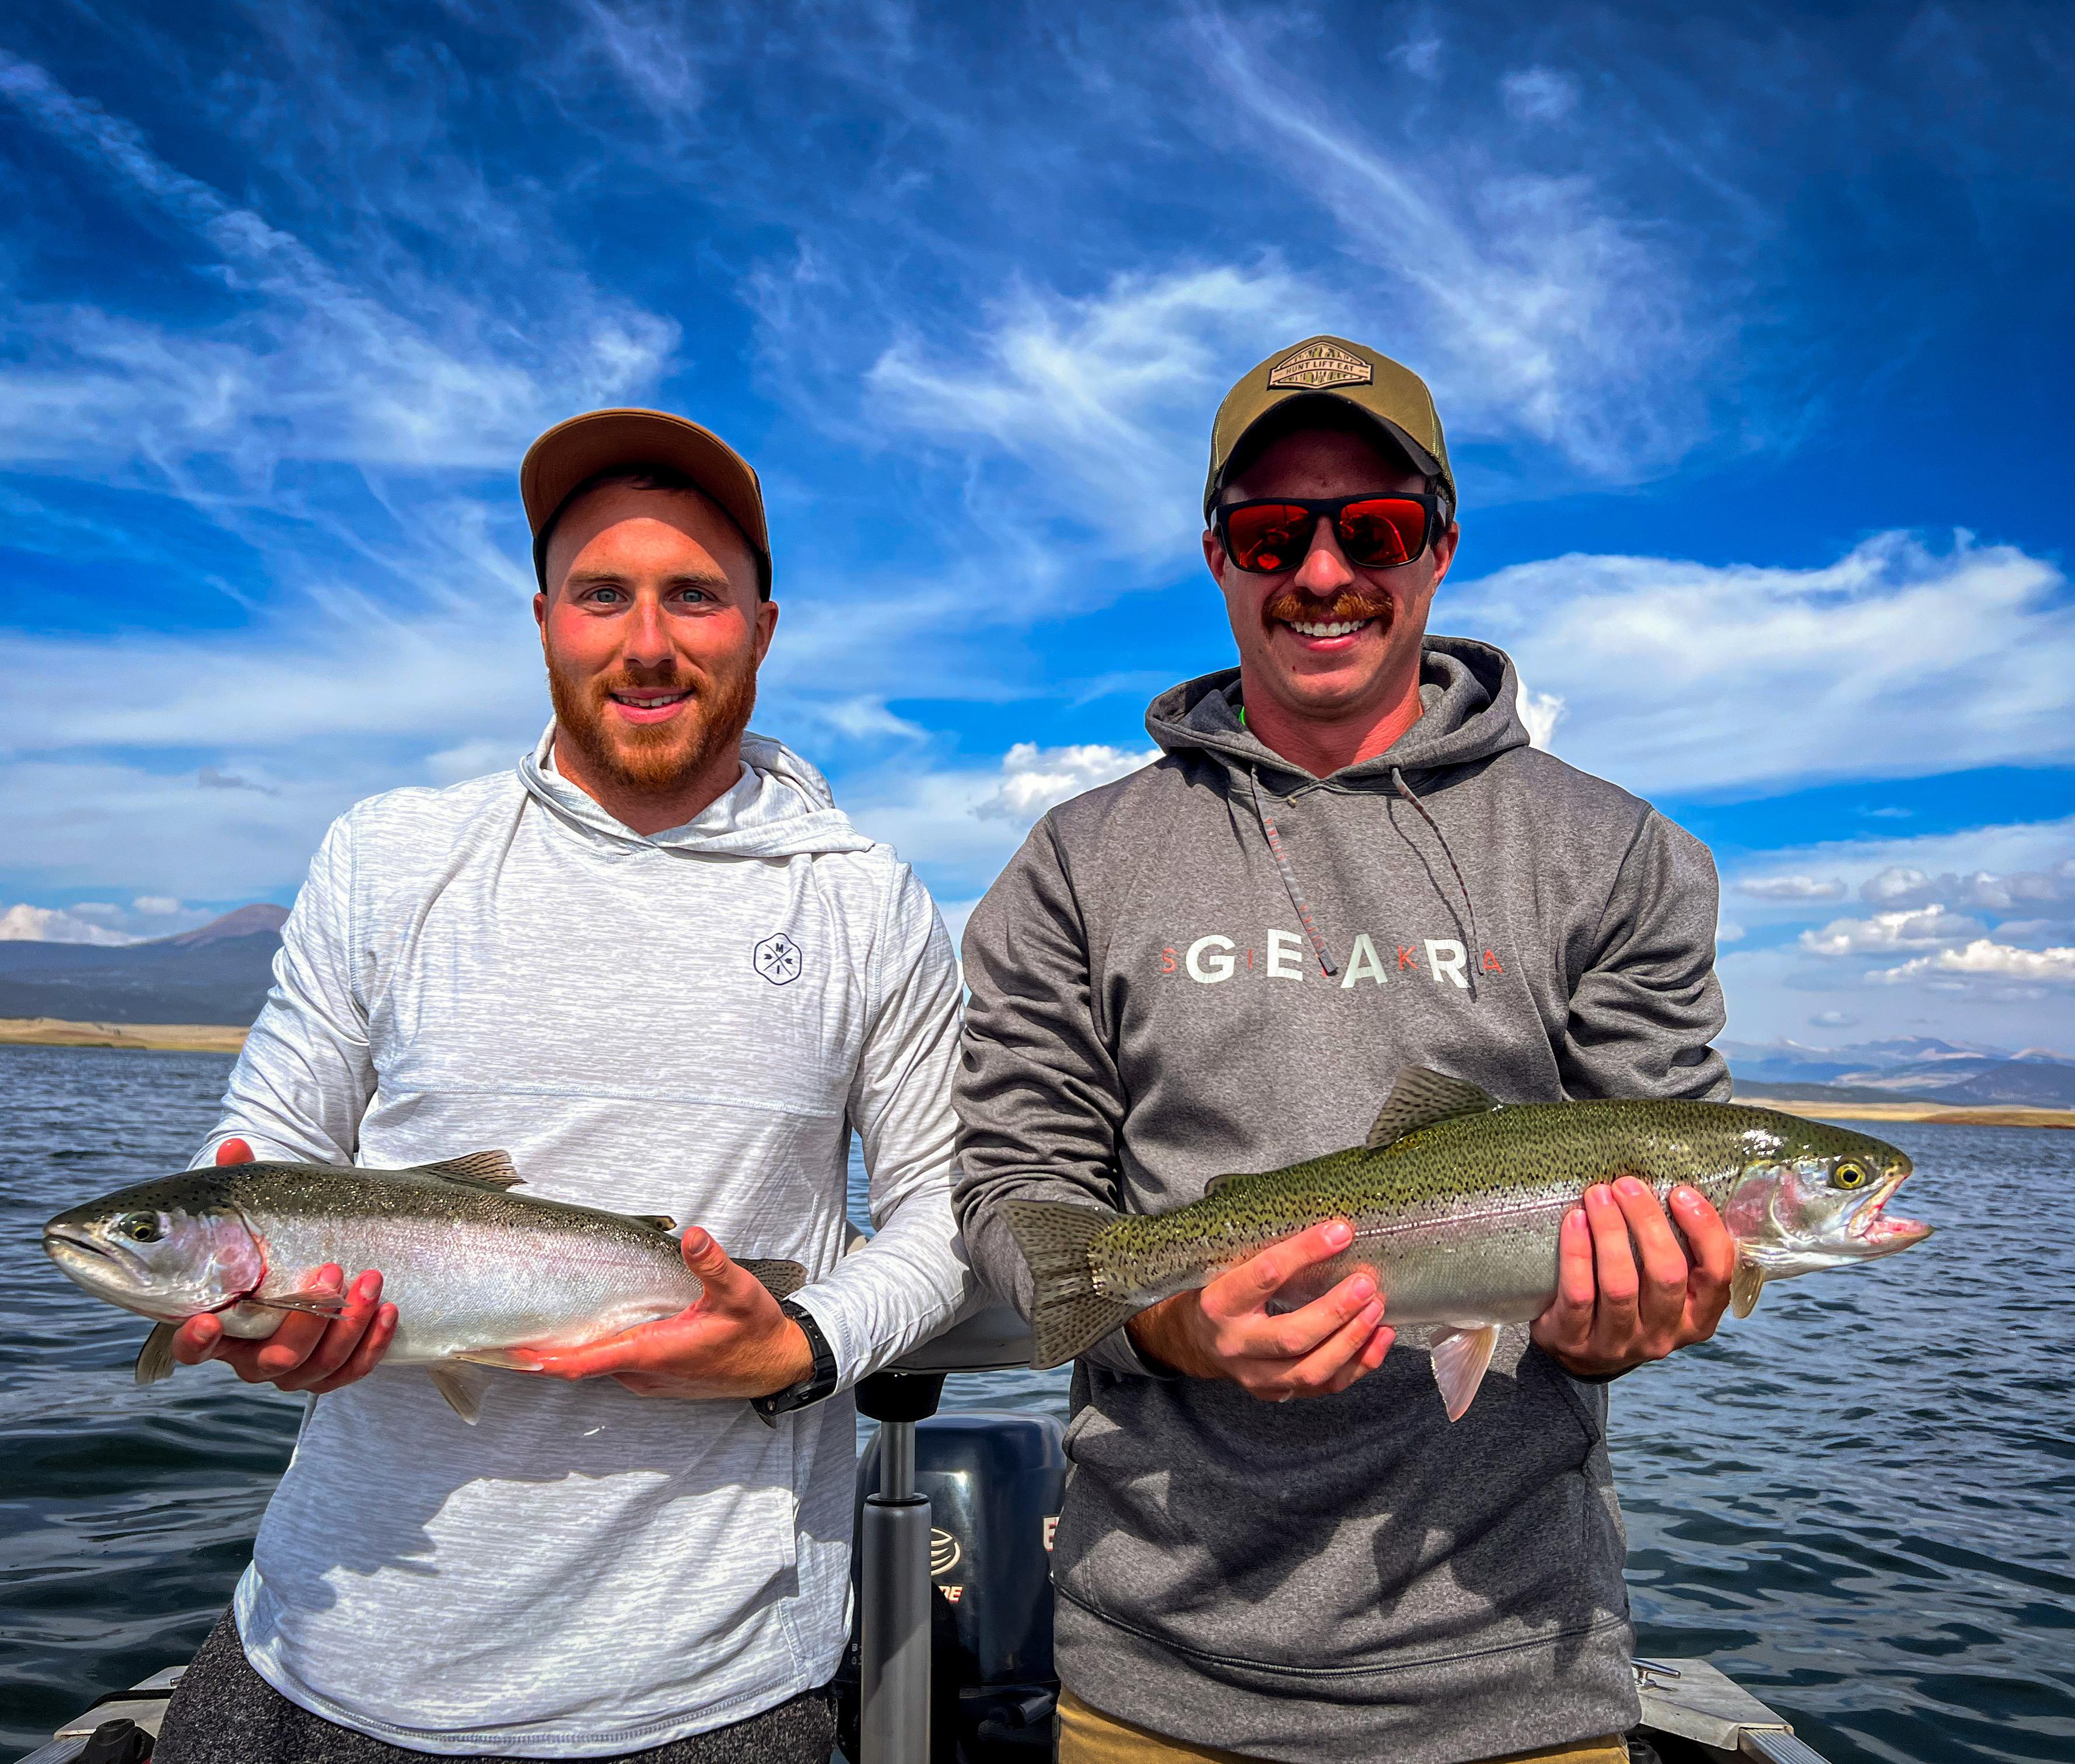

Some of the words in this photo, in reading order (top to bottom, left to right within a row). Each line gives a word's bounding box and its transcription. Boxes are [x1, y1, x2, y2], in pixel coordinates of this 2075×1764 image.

[1286, 362, 1310, 374] HUNT
[1337, 362, 1354, 372] EAT
[1161, 945, 1503, 978] SIKA
[1185, 929, 1473, 989] GEAR
